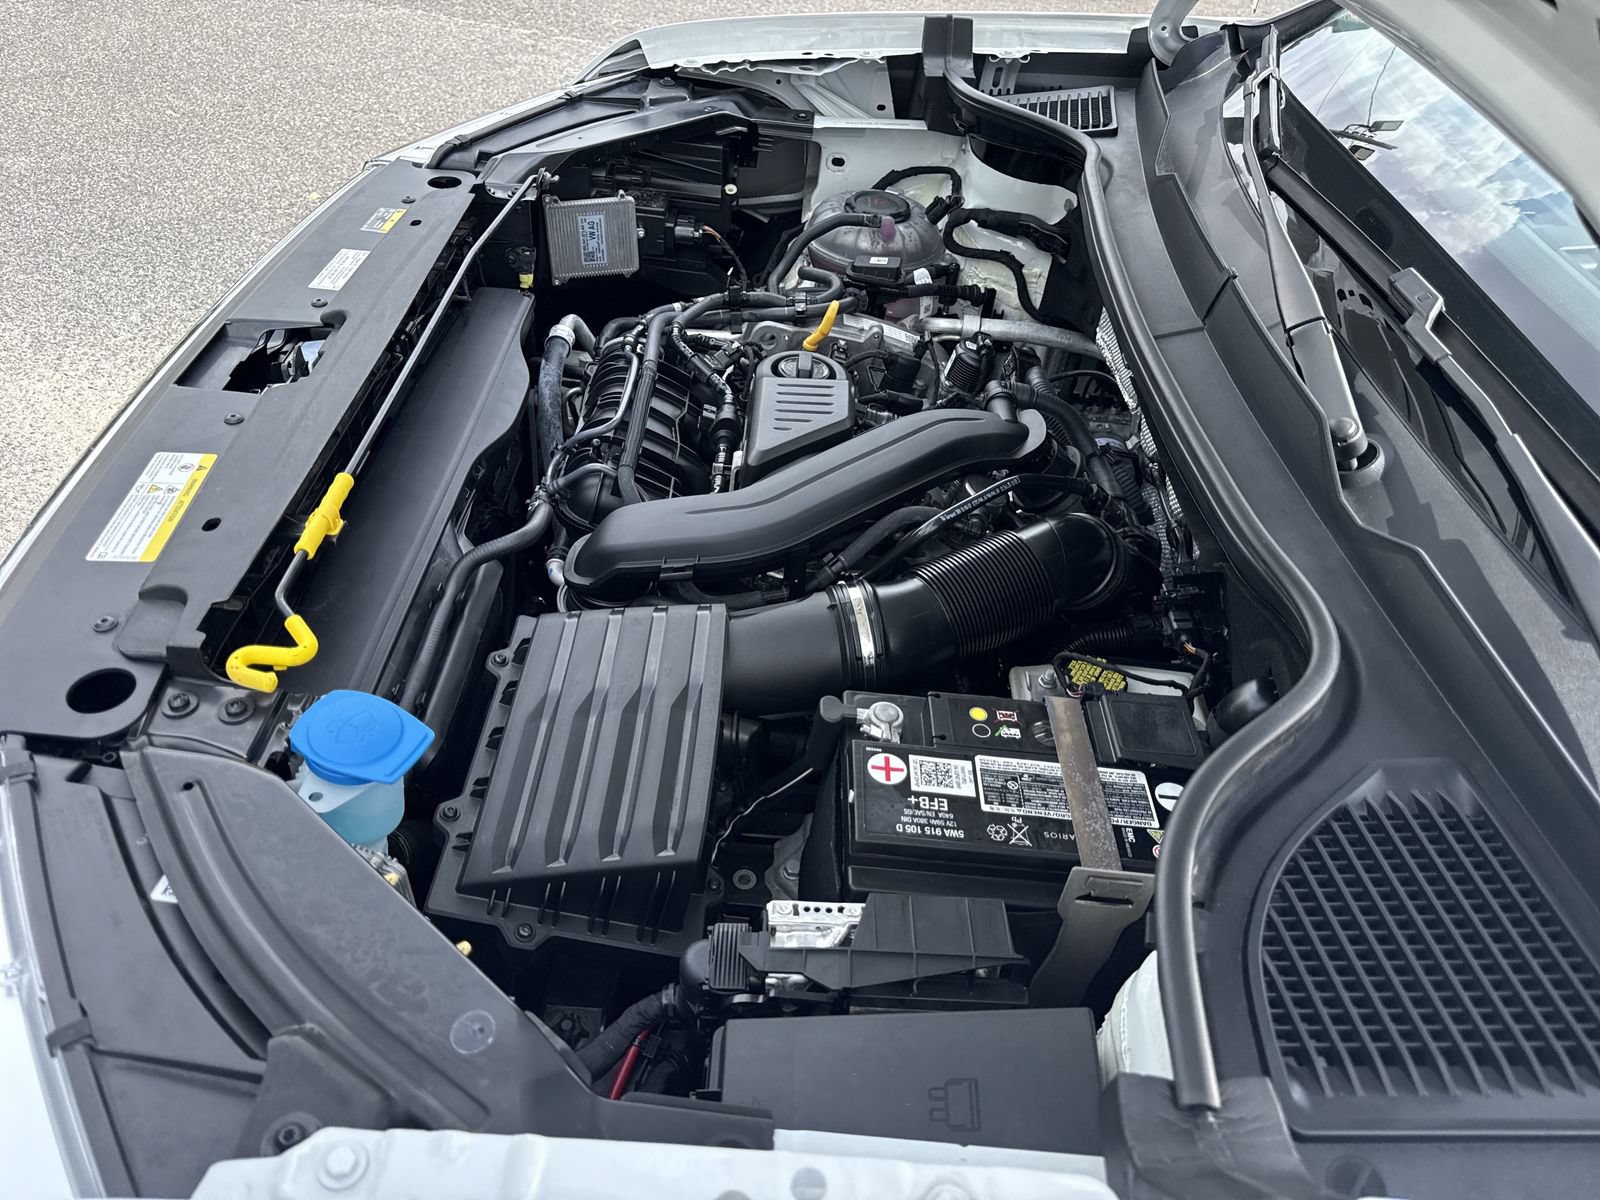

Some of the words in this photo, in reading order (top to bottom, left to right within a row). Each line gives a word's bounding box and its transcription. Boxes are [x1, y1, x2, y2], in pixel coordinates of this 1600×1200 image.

[587, 221, 595, 230] AG
[588, 231, 596, 240] VW
[907, 795, 948, 811] EFB+
[1011, 816, 1023, 824] Pb
[1111, 819, 1153, 827] DANGER/PO
[895, 823, 903, 833] D
[905, 824, 922, 834] 105
[924, 826, 942, 836] 915
[943, 828, 965, 838] 5WA
[1043, 831, 1075, 840] ARIOS
[1125, 827, 1136, 843] EMC
